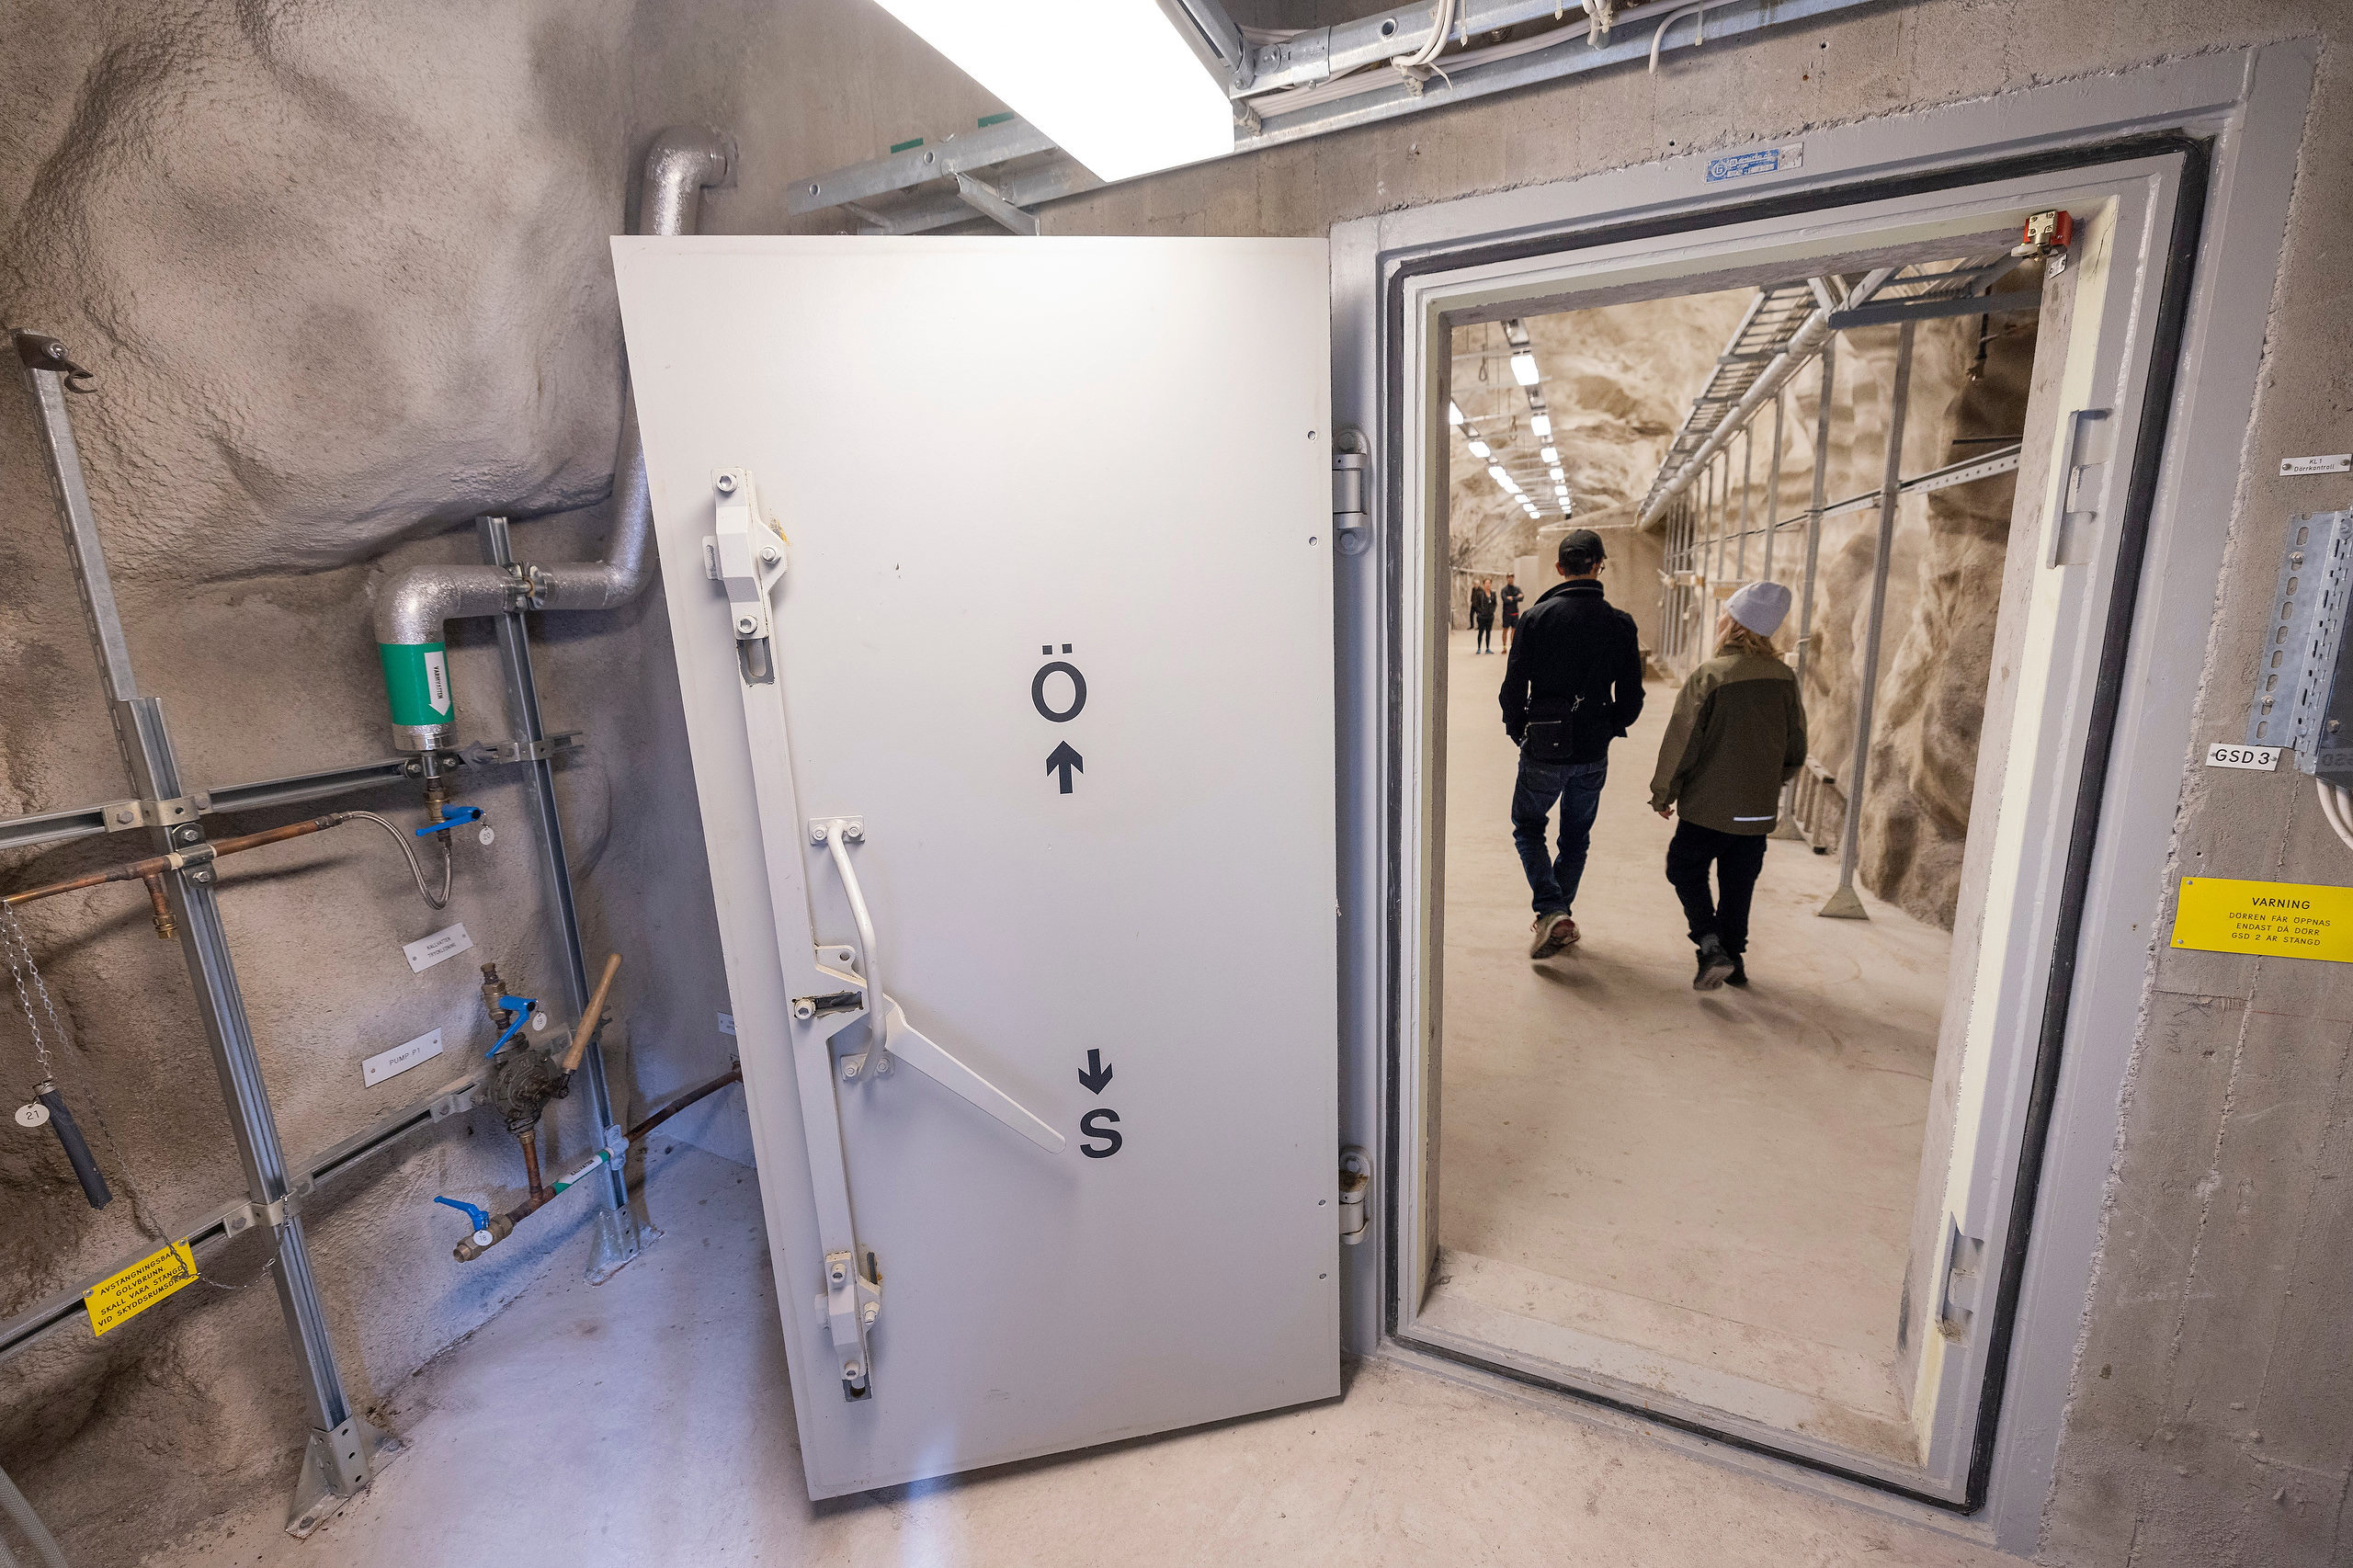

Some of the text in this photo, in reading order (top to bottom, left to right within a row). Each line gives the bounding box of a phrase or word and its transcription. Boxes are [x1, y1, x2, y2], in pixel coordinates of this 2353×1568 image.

[1031, 643, 1087, 723] Ö
[2215, 748, 2270, 765] GSD 3
[2252, 897, 2311, 910] VARNING
[2229, 912, 2331, 927] DÖRREN FÅR ÖPPNAS
[2236, 922, 2320, 936] ENDAST DÅ DÖRR
[389, 1048, 421, 1066] PUMP P1
[26, 1109, 40, 1120] 21
[1079, 1108, 1123, 1159] S
[115, 1266, 164, 1297] GOLVBRUNN
[100, 1298, 126, 1316] SKALL
[129, 1285, 150, 1300] VARA
[97, 1315, 113, 1327] VID
